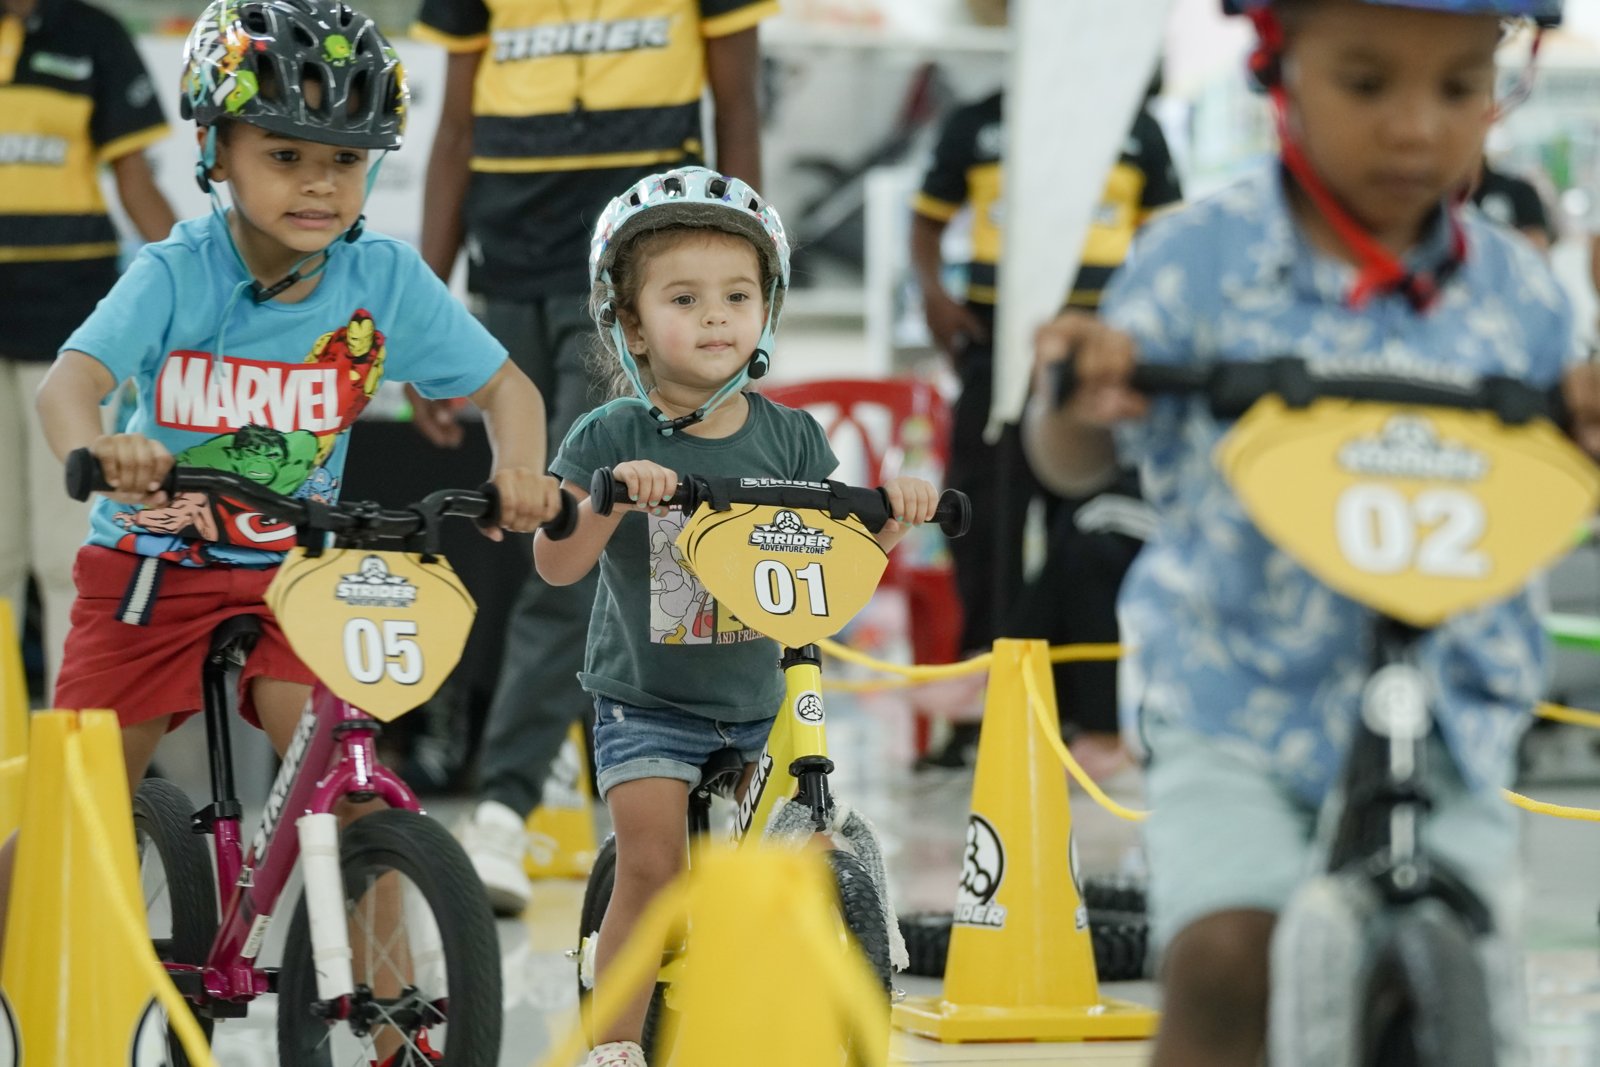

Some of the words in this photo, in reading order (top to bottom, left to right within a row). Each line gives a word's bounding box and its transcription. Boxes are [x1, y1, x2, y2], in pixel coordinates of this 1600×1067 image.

[160, 356, 343, 432] MARVEL
[749, 531, 832, 550] STRIDER
[760, 544, 803, 554] ADVENTURE
[805, 547, 825, 555] ZONE
[1334, 483, 1491, 578] 02
[336, 582, 418, 600] STRIDER
[754, 559, 829, 617] 01
[343, 617, 424, 685] 05
[716, 632, 736, 645] AND
